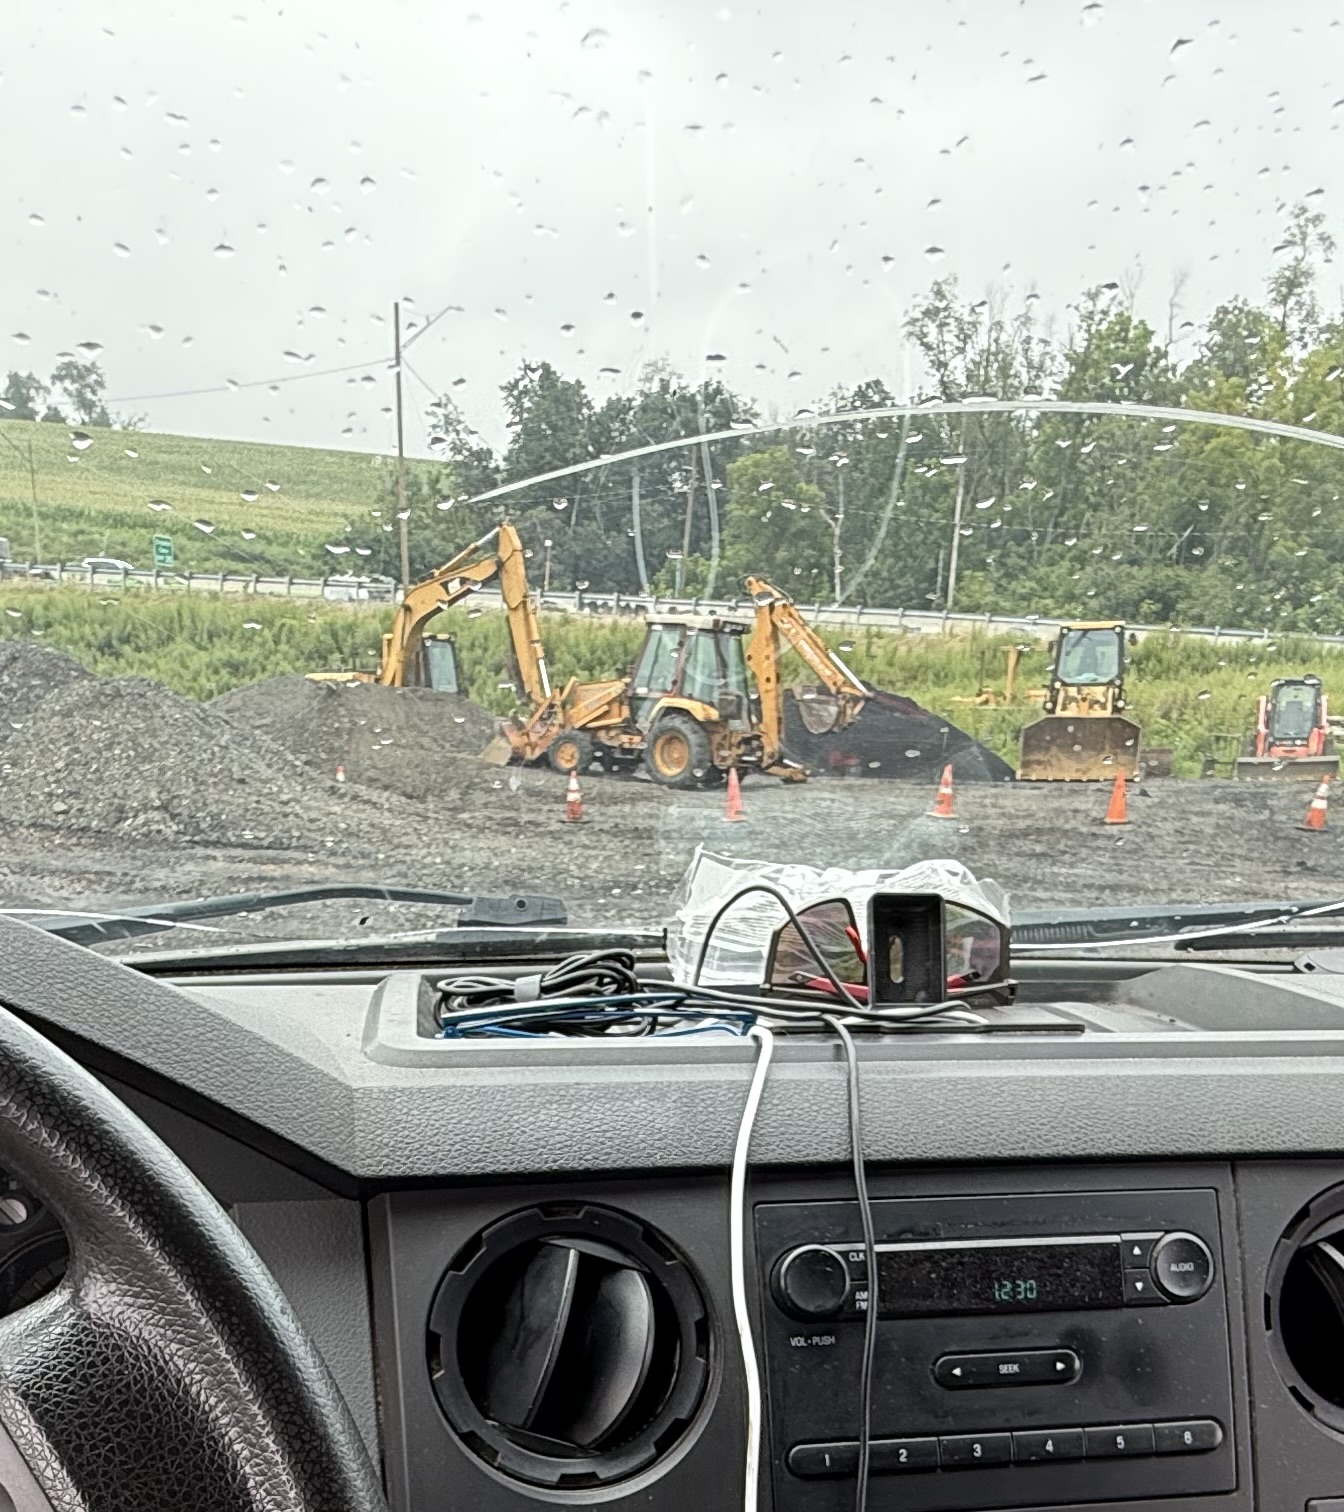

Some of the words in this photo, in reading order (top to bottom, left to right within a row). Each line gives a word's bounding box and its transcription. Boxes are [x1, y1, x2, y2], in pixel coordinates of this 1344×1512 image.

[849, 1253, 865, 1262] CLK
[999, 1364, 1020, 1374] SEEK
[824, 1453, 831, 1467] 1
[898, 1449, 908, 1463] 2
[972, 1443, 982, 1457] 3
[1045, 1438, 1054, 1452] 4
[1116, 1436, 1125, 1449] 5
